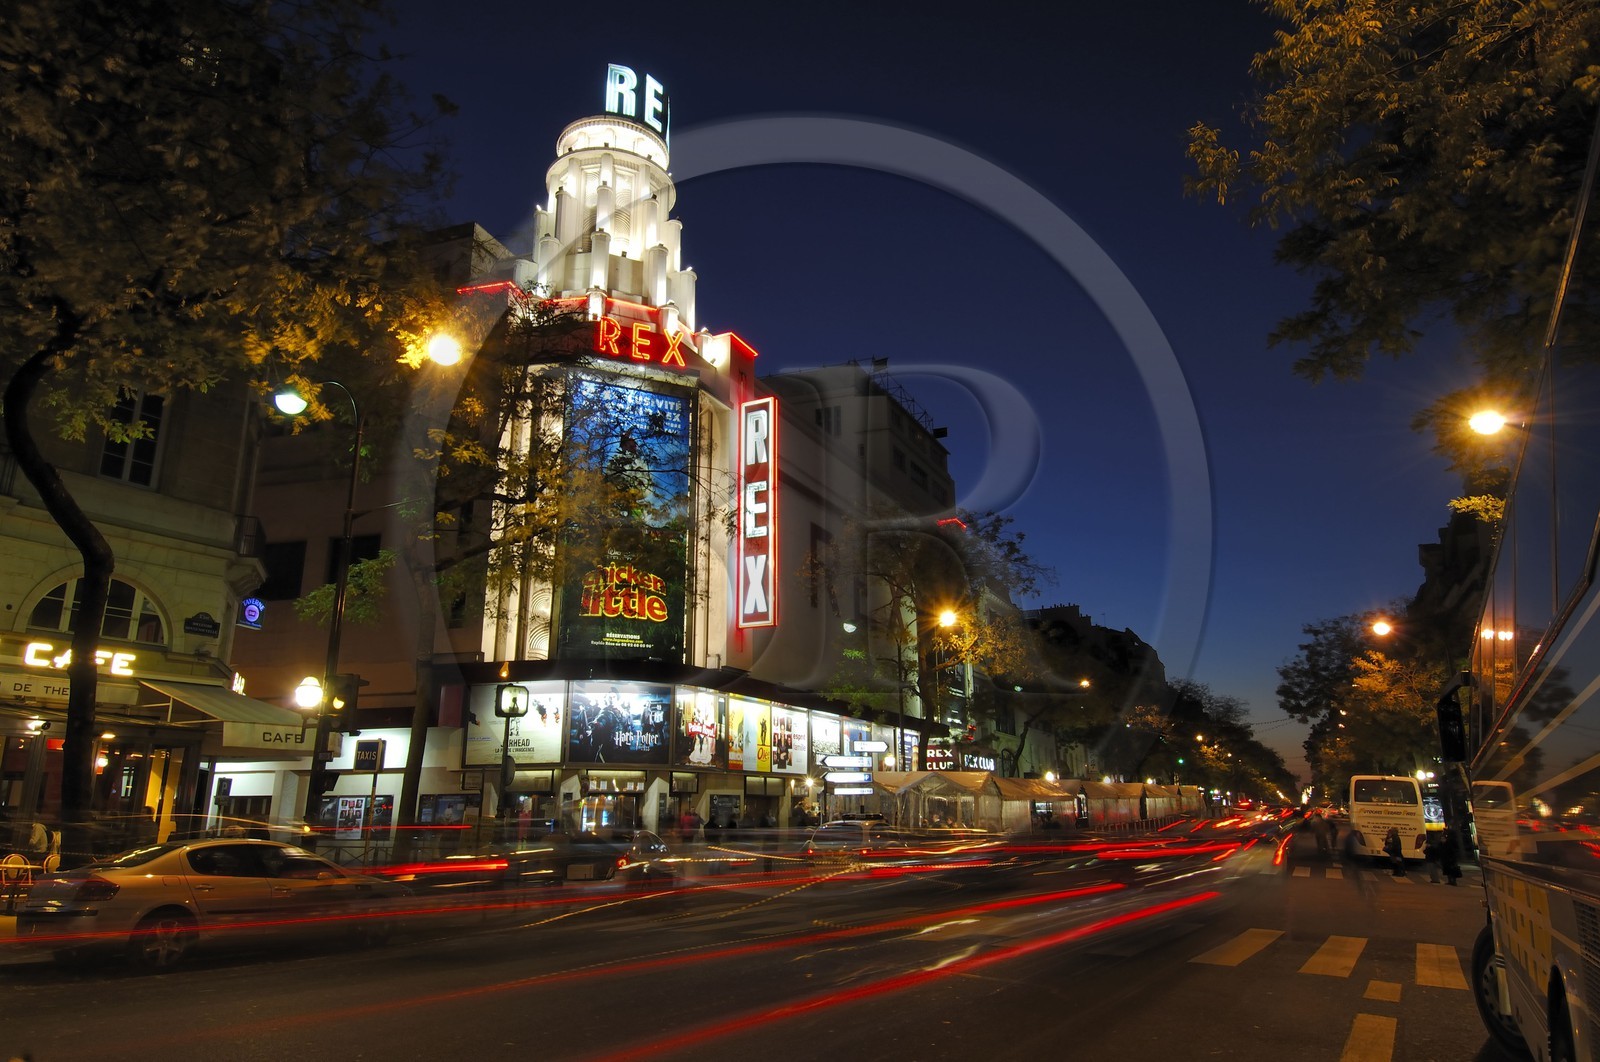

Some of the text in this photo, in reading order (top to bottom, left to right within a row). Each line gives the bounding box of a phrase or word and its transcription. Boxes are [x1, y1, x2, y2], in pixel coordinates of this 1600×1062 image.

[605, 63, 669, 147] RE
[599, 315, 686, 367] REX
[743, 409, 768, 614] REX
[242, 597, 265, 611] TAVERNE
[579, 583, 668, 622] little
[13, 682, 69, 696] DE THE
[262, 731, 304, 744] CAFE
[500, 739, 531, 748] JRHEAD
[614, 730, 633, 747] Harry
[636, 729, 659, 751] Potter
[357, 750, 377, 761] TAXIS
[926, 749, 953, 758] REX
[979, 756, 995, 771] CLUB
